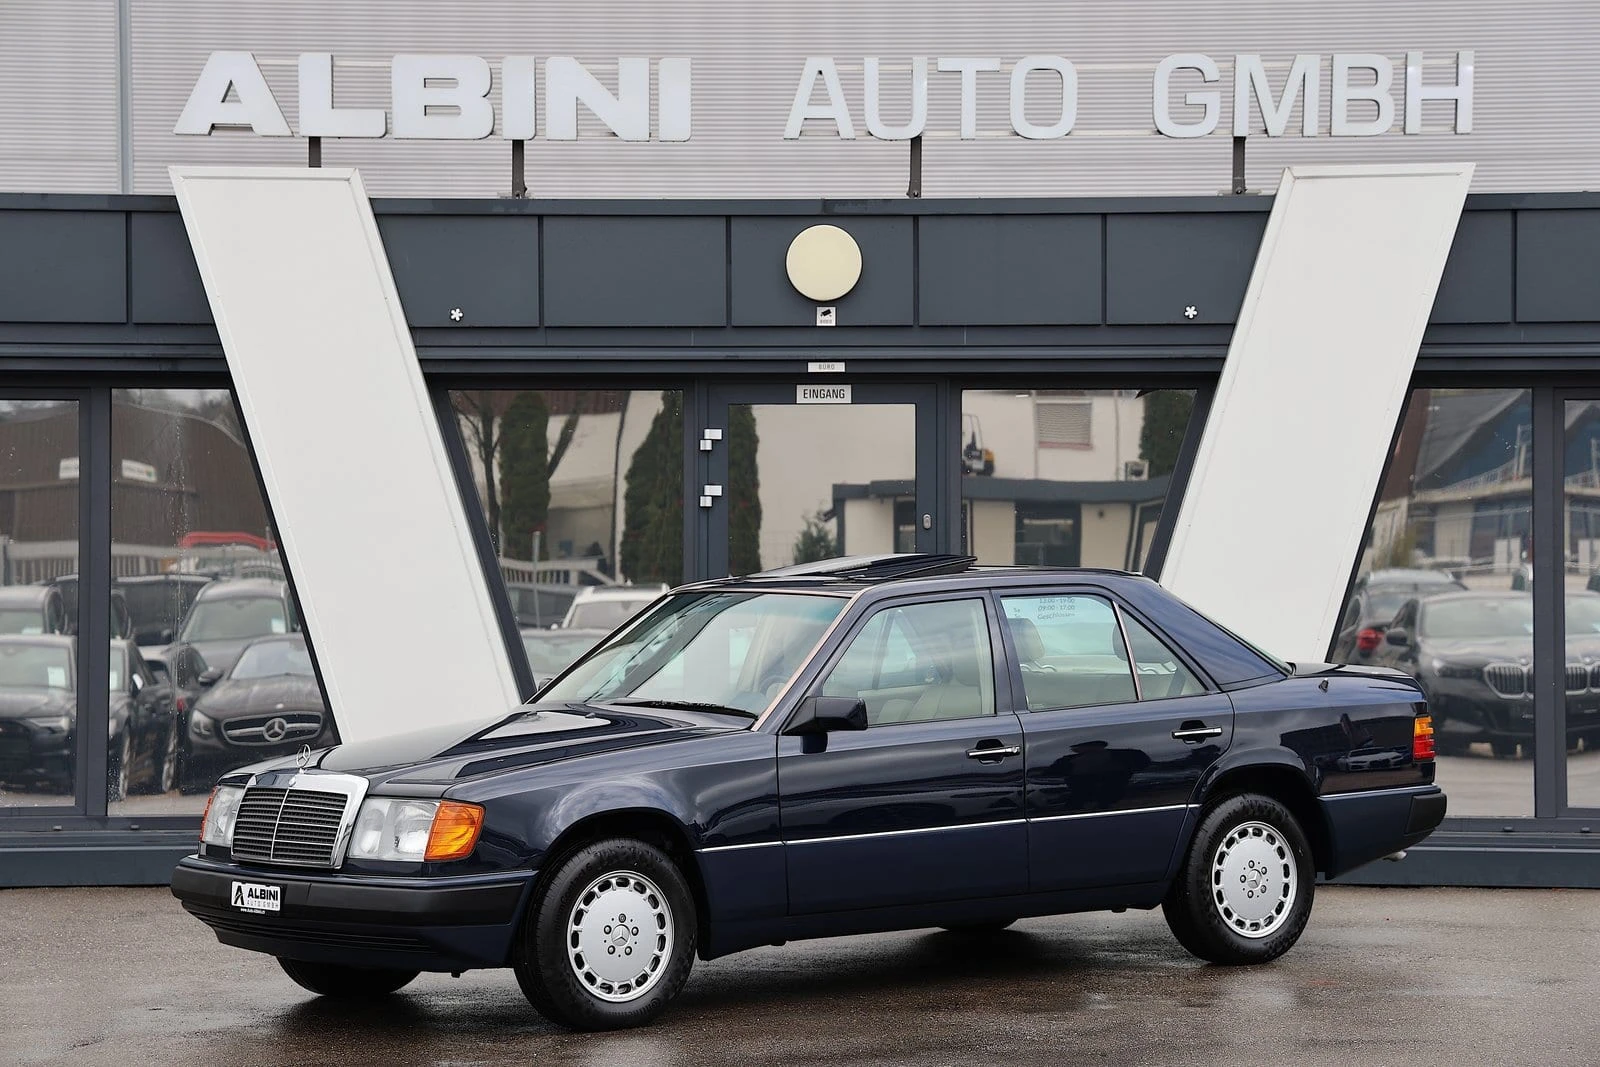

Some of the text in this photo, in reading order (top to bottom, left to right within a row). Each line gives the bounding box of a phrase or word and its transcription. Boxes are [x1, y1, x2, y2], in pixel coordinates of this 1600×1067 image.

[173, 50, 1475, 142] ALBINI AUTO GMBH
[803, 388, 845, 399] EINGANG
[247, 888, 278, 901] ALBINI
